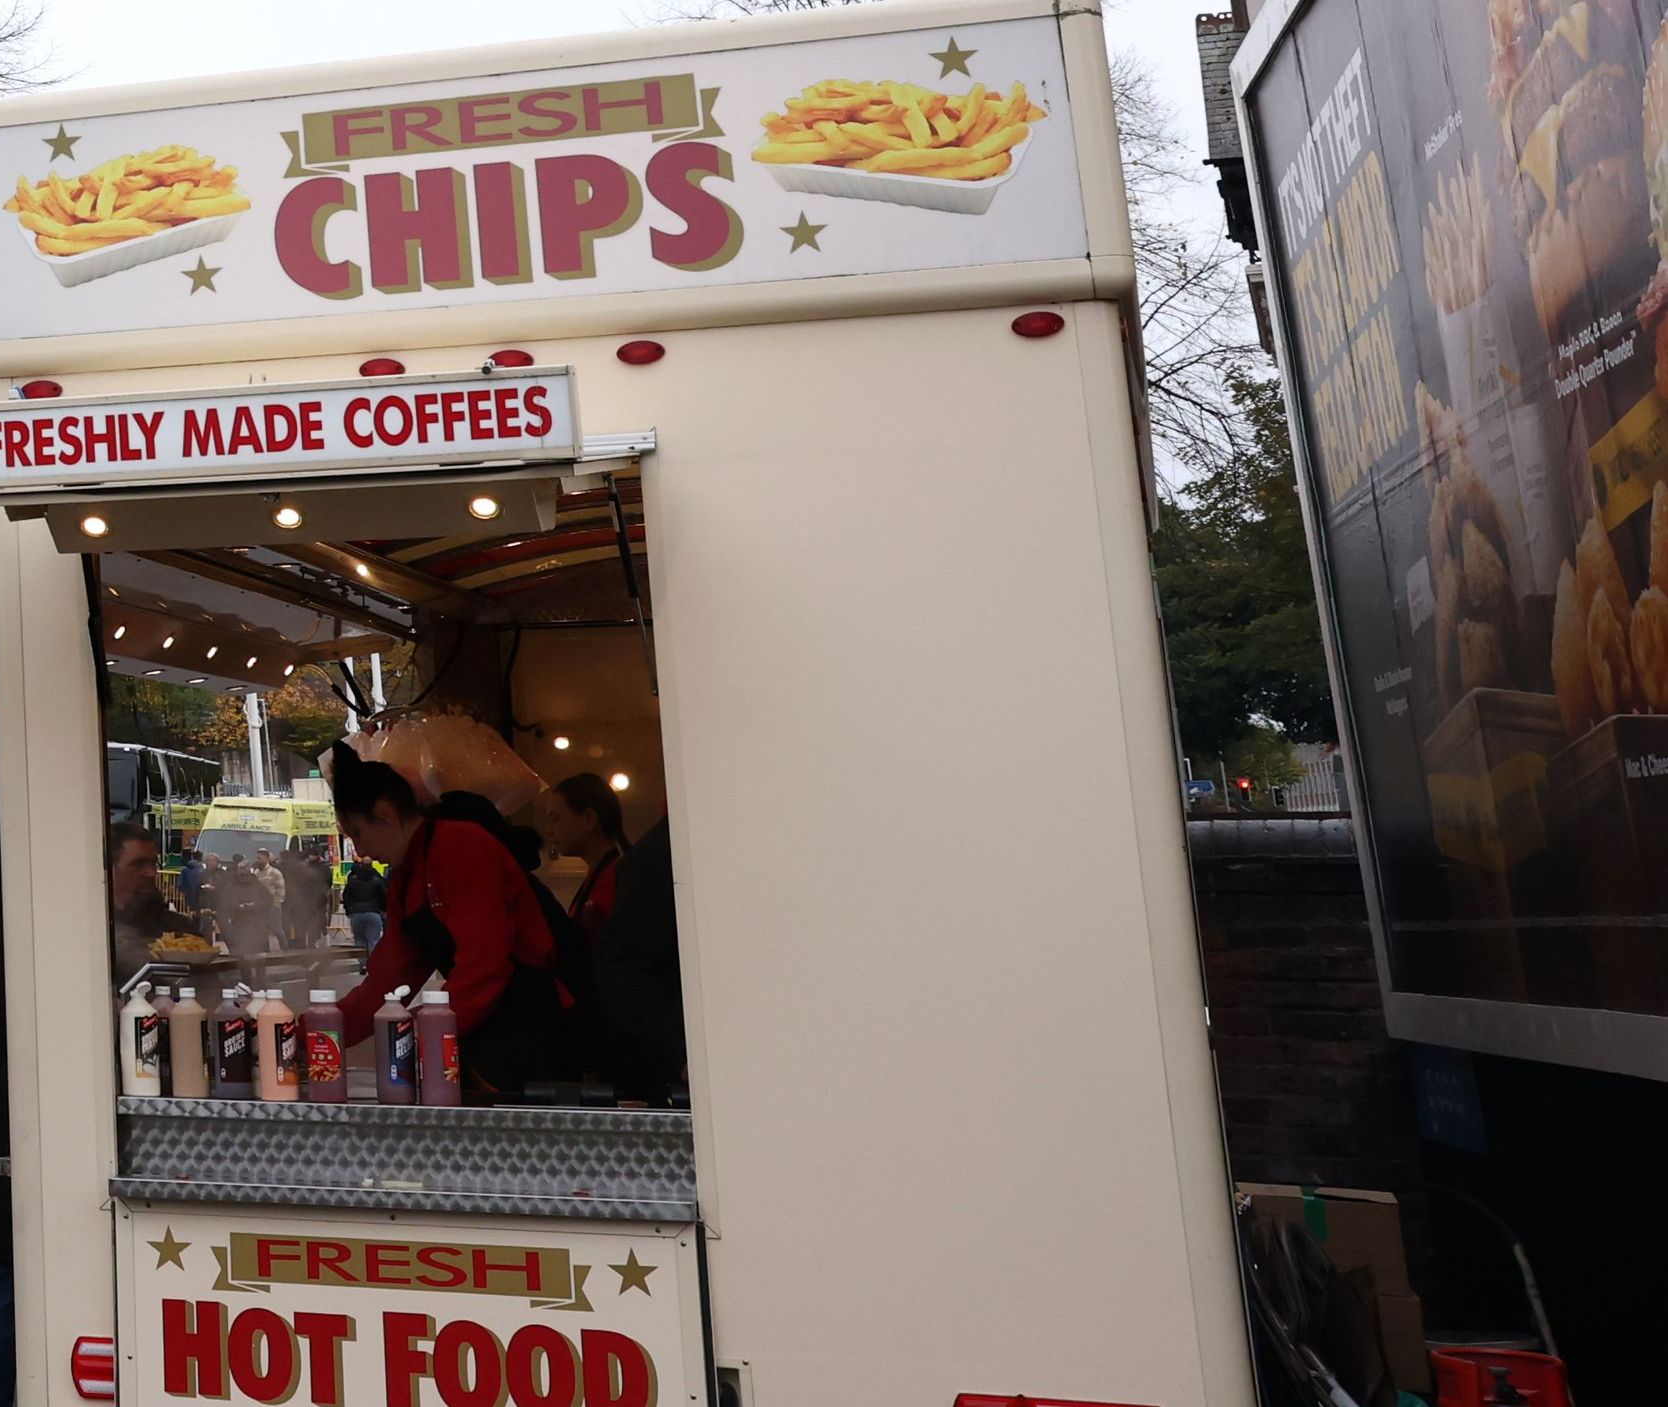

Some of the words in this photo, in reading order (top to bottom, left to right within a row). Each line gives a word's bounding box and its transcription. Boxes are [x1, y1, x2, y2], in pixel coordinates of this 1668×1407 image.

[330, 79, 666, 158] FRESH
[1278, 161, 1307, 260] IT'S
[1297, 116, 1330, 226] NOT
[1320, 47, 1371, 184] THEFT
[273, 142, 745, 301] CHIPS
[1600, 312, 1623, 333] Bacon
[1579, 356, 1604, 387] Quarter
[180, 401, 325, 458] MADE
[342, 385, 554, 449] COFFEES
[256, 1237, 543, 1292] FRESH
[162, 1298, 356, 1405] HOT
[382, 1310, 658, 1407] FOOD
